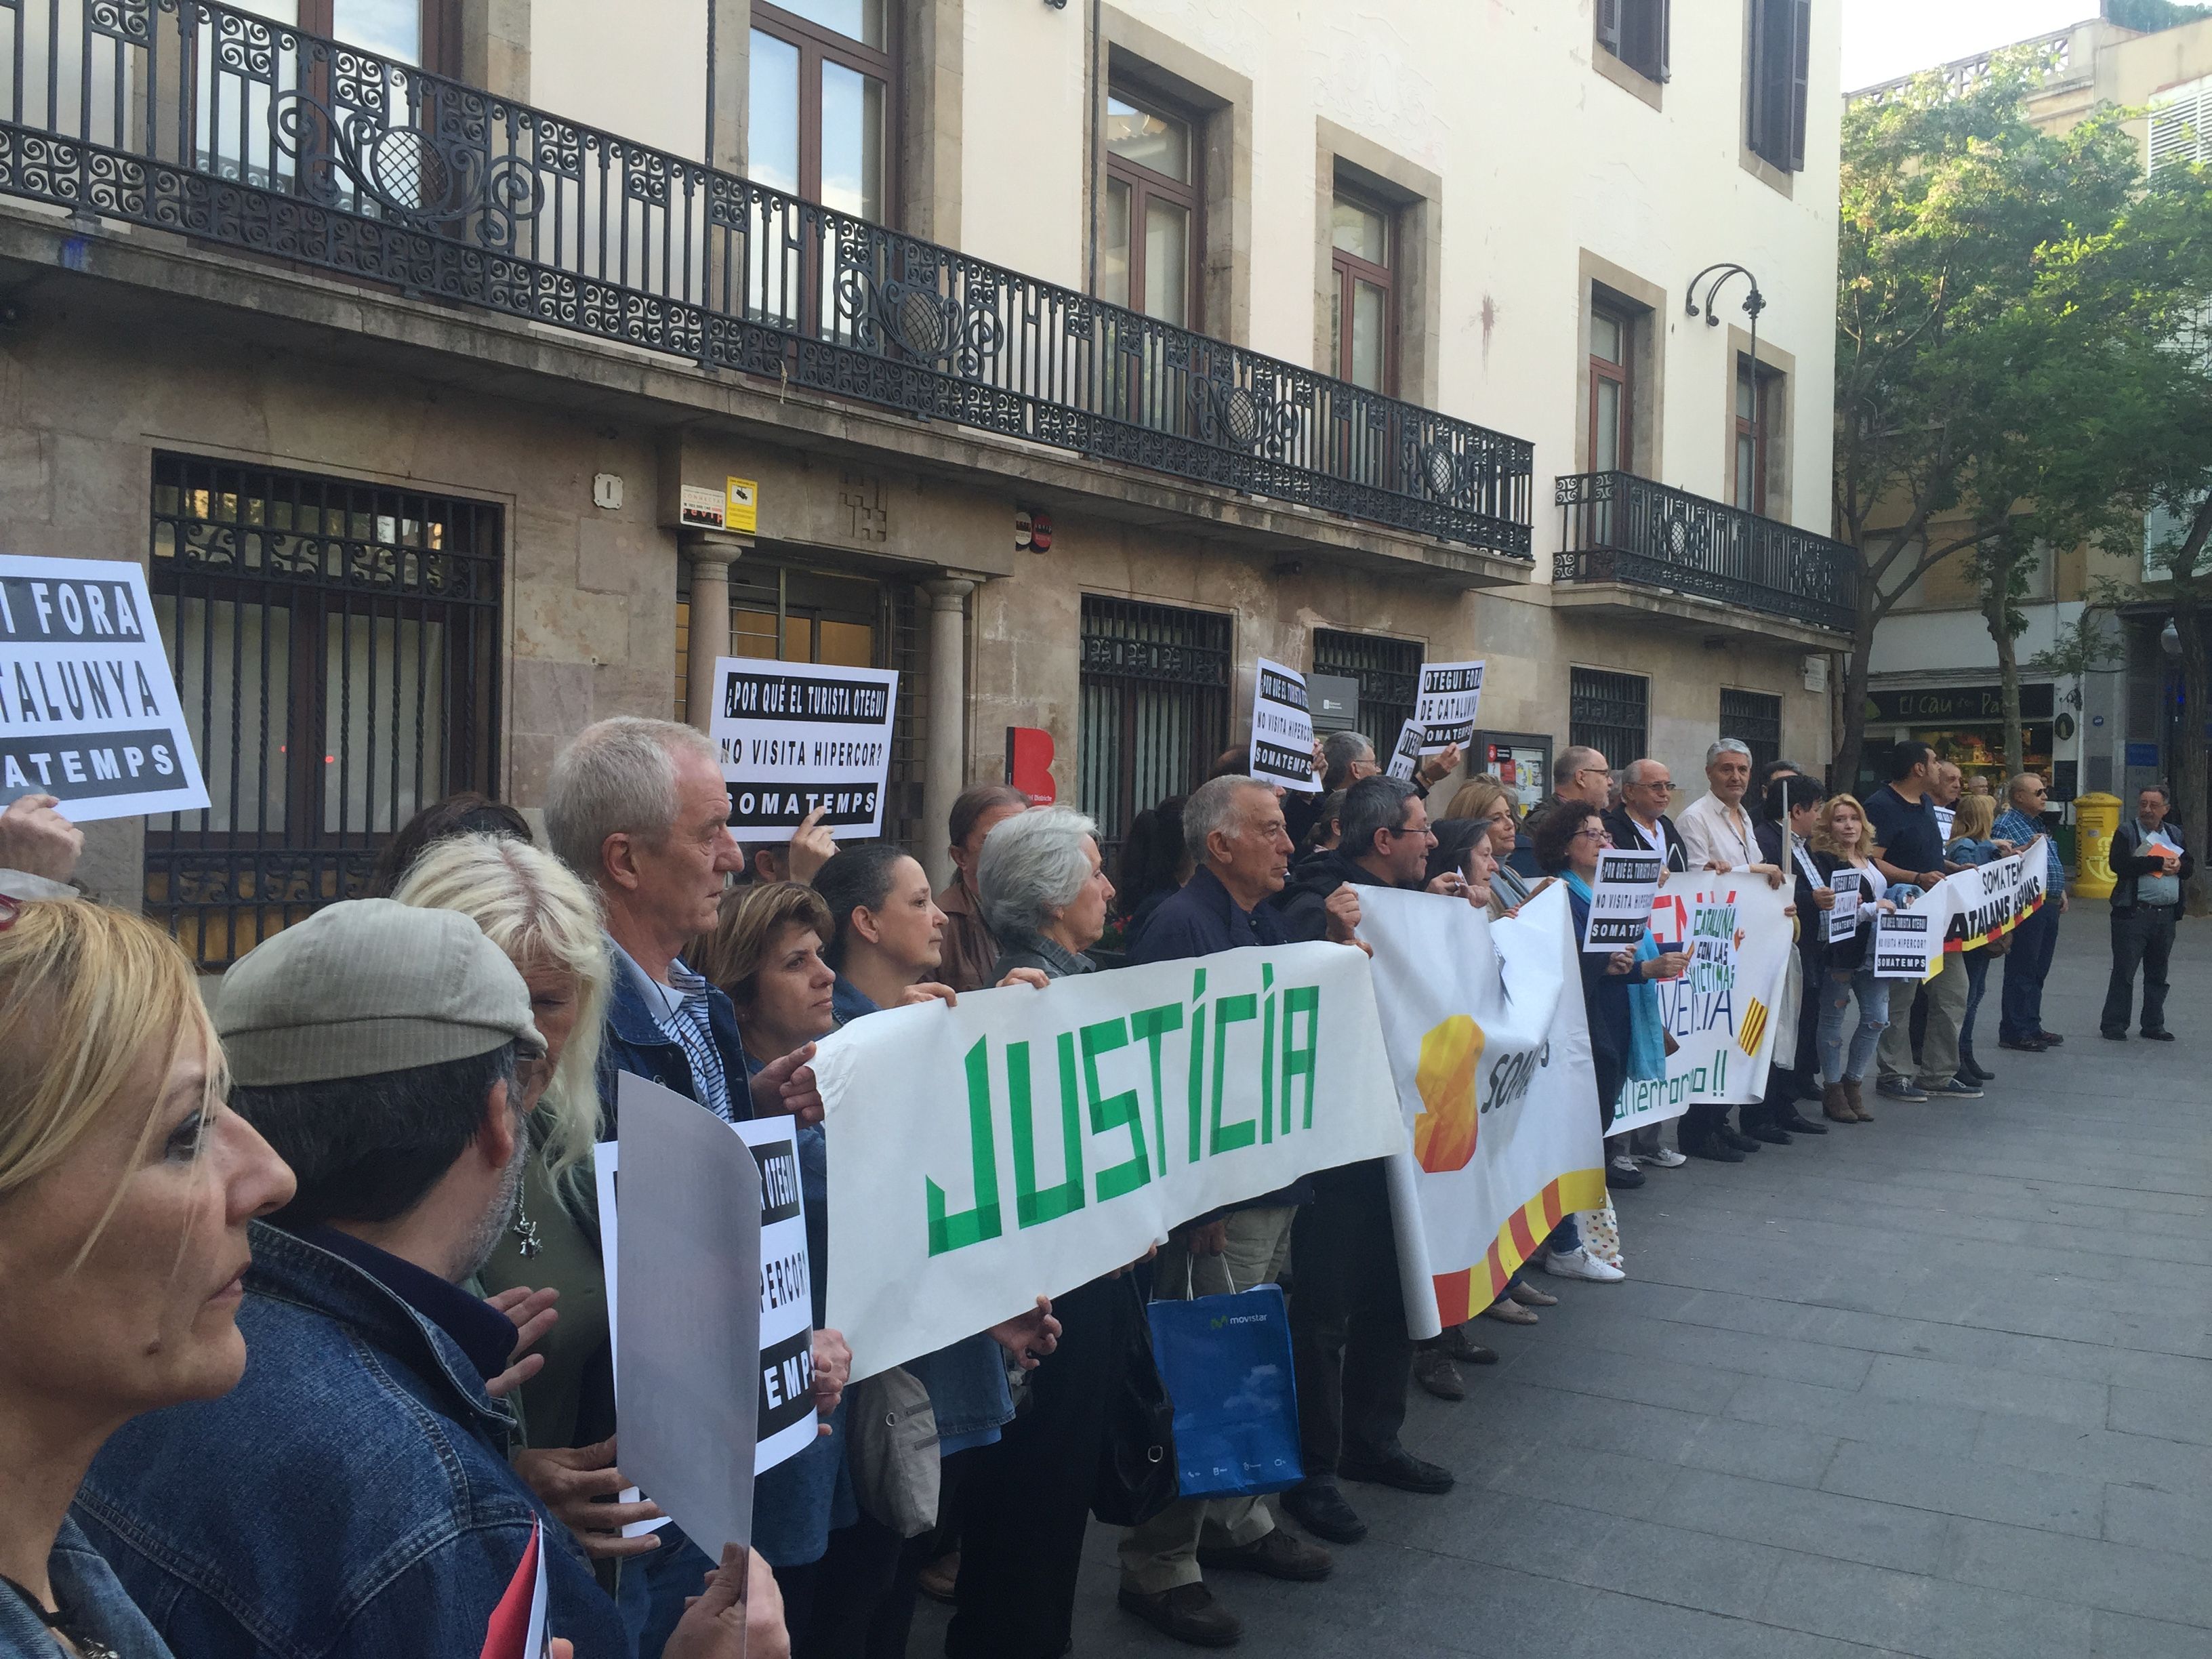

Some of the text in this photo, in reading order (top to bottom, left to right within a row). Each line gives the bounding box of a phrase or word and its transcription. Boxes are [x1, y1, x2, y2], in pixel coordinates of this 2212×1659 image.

[30, 582, 140, 635] FORA
[1425, 671, 1463, 691] OTEGUI
[726, 678, 886, 718] ¿POR QUÉ EL TURISTA OTEGUI
[1420, 699, 1433, 721] DE
[1268, 714, 1286, 735] VISITA
[1424, 724, 1472, 742] OMATEMPS
[721, 738, 882, 766] NO VISITA HIPERCOR?
[1255, 746, 1312, 775] SOMATEMPS
[5, 744, 174, 788] ATEMPS
[1595, 894, 1606, 909] NO
[1609, 894, 1632, 909] VISITA
[1714, 942, 1728, 966] LAS
[1878, 958, 1926, 968] SOMATEMPS
[764, 1154, 798, 1209] OTEGUI
[1229, 1313, 1268, 1325] movistar
